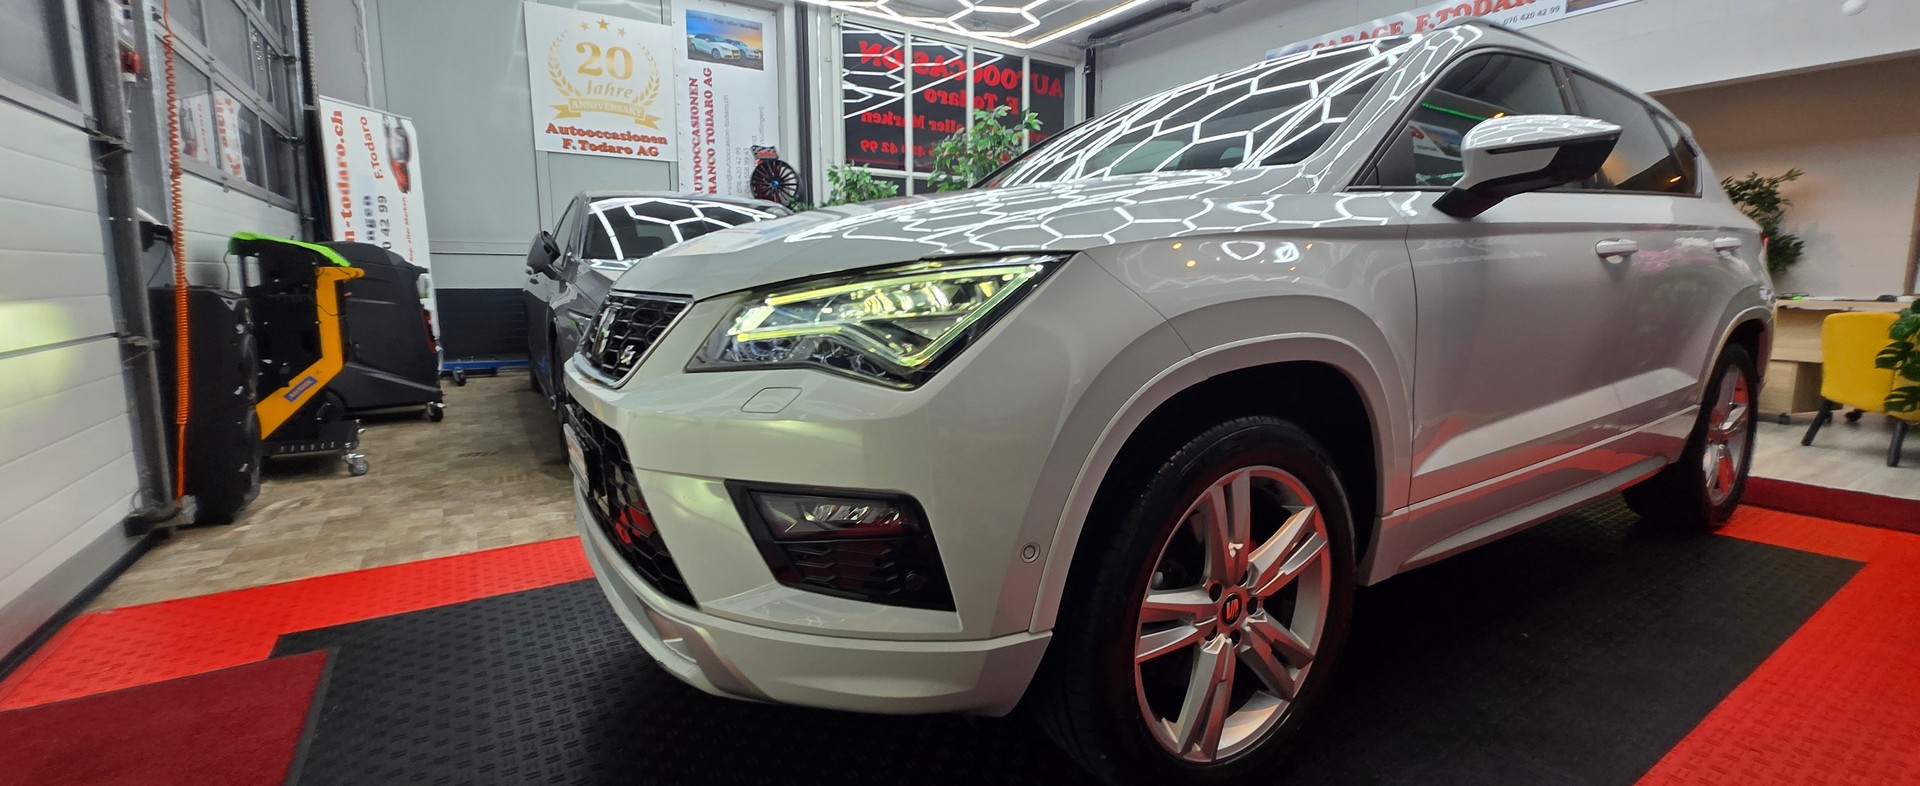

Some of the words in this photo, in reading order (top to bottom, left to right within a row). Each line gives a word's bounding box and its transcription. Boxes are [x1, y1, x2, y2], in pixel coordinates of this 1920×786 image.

[1503, 16, 1518, 26] 076
[1520, 12, 1536, 21] 420
[1537, 9, 1548, 17] 42
[1549, 5, 1561, 14] 99
[575, 41, 634, 81] 20
[703, 67, 713, 88] AG
[586, 79, 634, 99] Jahre
[571, 99, 642, 118] ANNIVERSARY
[704, 89, 716, 146] TODARO
[545, 122, 668, 145] Autooccasionen
[360, 116, 384, 180] F.Todaro
[636, 145, 660, 157] AG
[376, 195, 389, 213] 99
[379, 218, 391, 237] 42
